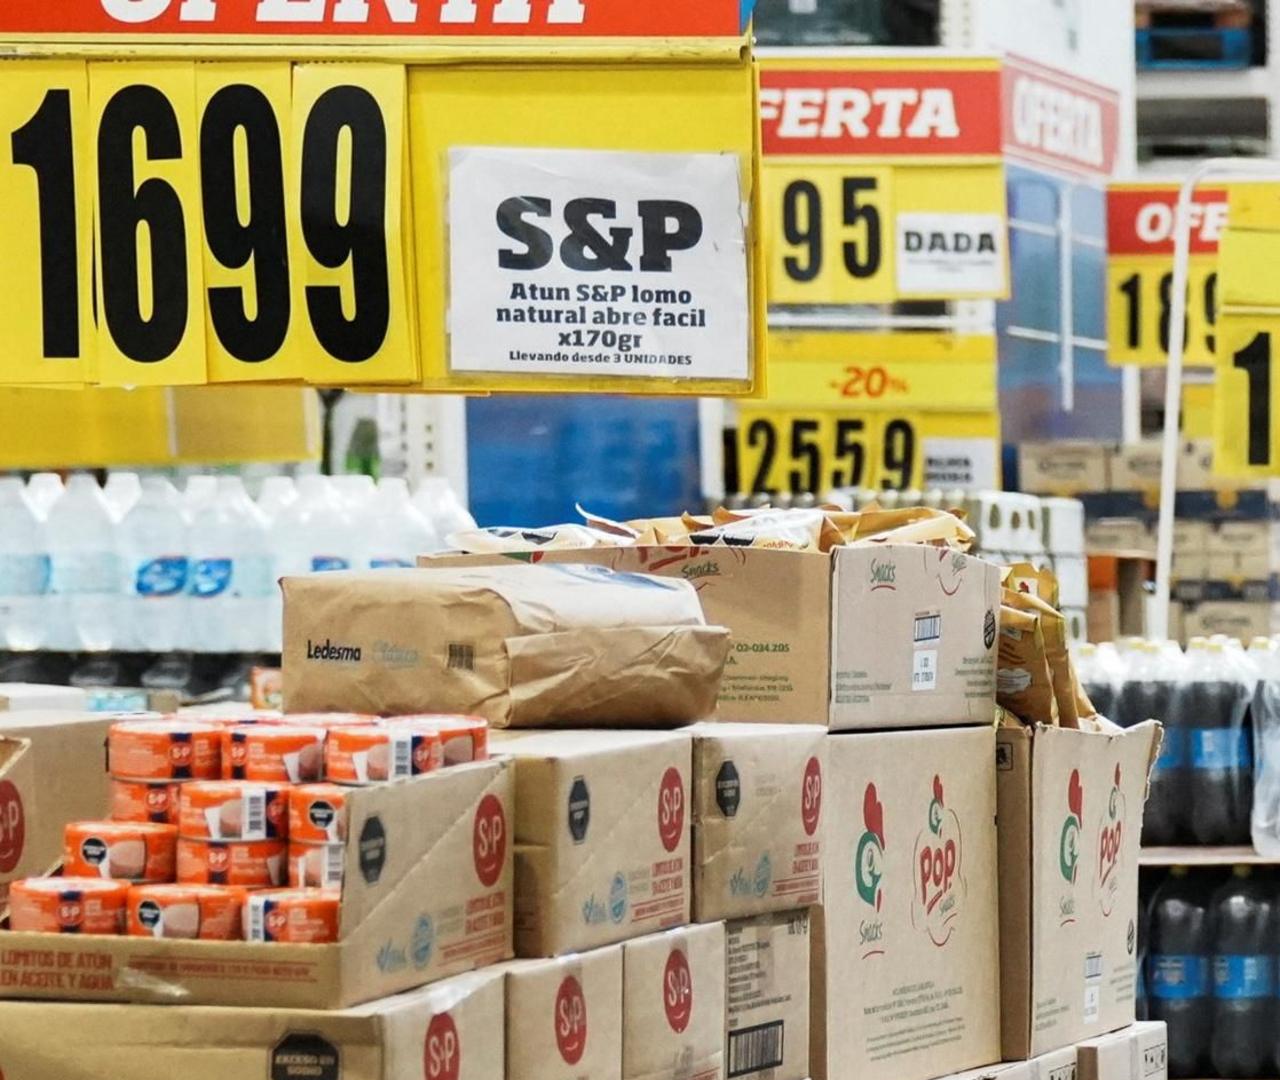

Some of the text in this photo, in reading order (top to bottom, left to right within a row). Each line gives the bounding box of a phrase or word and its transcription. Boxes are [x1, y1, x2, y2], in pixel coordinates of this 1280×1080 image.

[11, 84, 390, 363] 1699
[496, 196, 703, 272] S&P
[782, 177, 883, 283] 95
[905, 231, 996, 254] DADA
[510, 283, 692, 304] Atun S&P lomo
[496, 305, 706, 327] natural abre facil
[558, 330, 642, 351] x170gr
[509, 351, 692, 366] Llevando desde 3 UNIDADES
[307, 639, 361, 661] Ledesma
